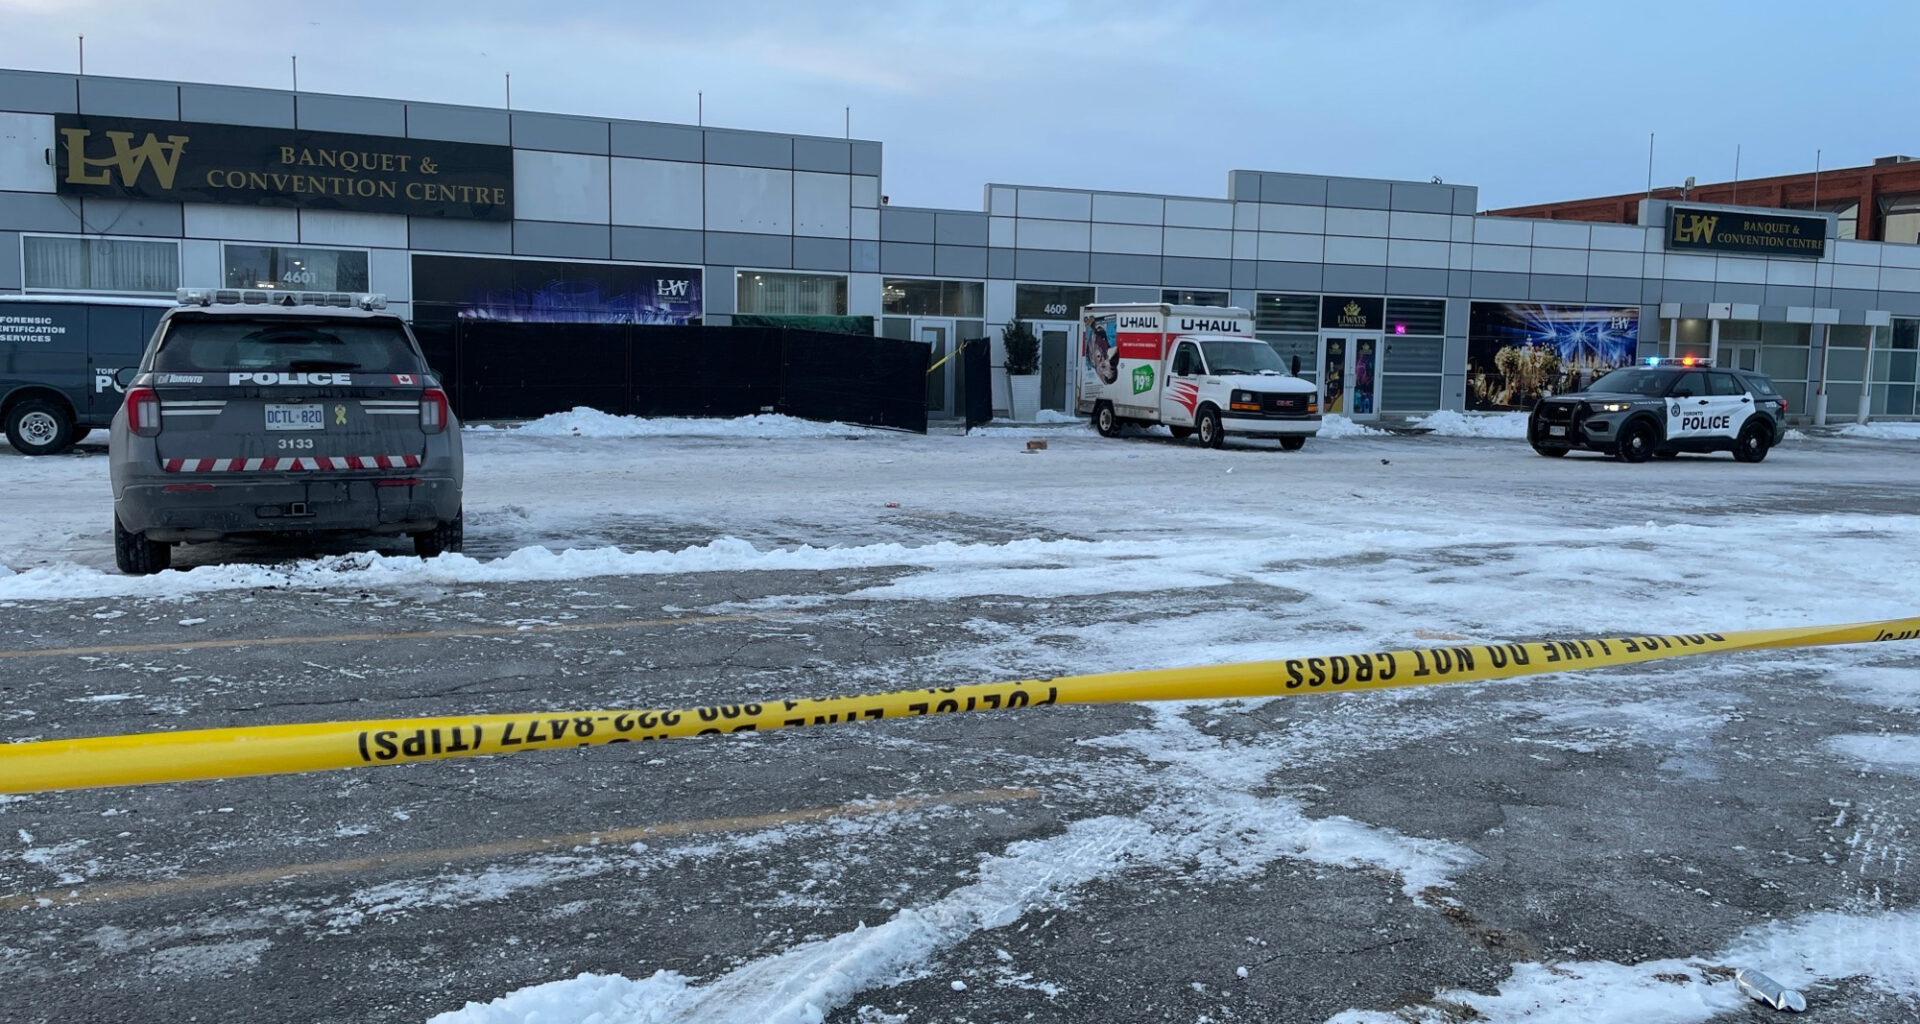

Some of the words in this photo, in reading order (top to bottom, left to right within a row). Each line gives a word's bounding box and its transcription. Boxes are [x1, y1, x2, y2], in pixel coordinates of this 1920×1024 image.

[60, 128, 190, 190] LW
[280, 146, 411, 173] BANQUET
[419, 157, 438, 175] &
[206, 169, 396, 198] CONVENTION
[405, 182, 506, 205] CENTRE
[1673, 213, 1719, 244] LW
[1743, 221, 1791, 235] BANQUET
[1792, 226, 1800, 235] &
[1717, 232, 1784, 247] CONVENTION
[1786, 238, 1823, 250] CENTRE
[283, 271, 316, 285] 4601
[656, 279, 689, 297] LW
[1043, 303, 1068, 315] 4609
[0, 316, 52, 325] FORENSIC
[1120, 316, 1159, 328] U-HAUL
[1181, 319, 1241, 332] U-HAUL
[0, 334, 52, 342] SERVICES
[228, 372, 352, 386] POLICE
[267, 410, 295, 423] DCTL
[301, 410, 322, 423] 820
[1681, 415, 1730, 430] POLICE
[278, 438, 314, 449] 3133
[1413, 647, 1476, 677] NOT
[1284, 652, 1397, 690] CROSS
[357, 725, 482, 762] (TIPS)
